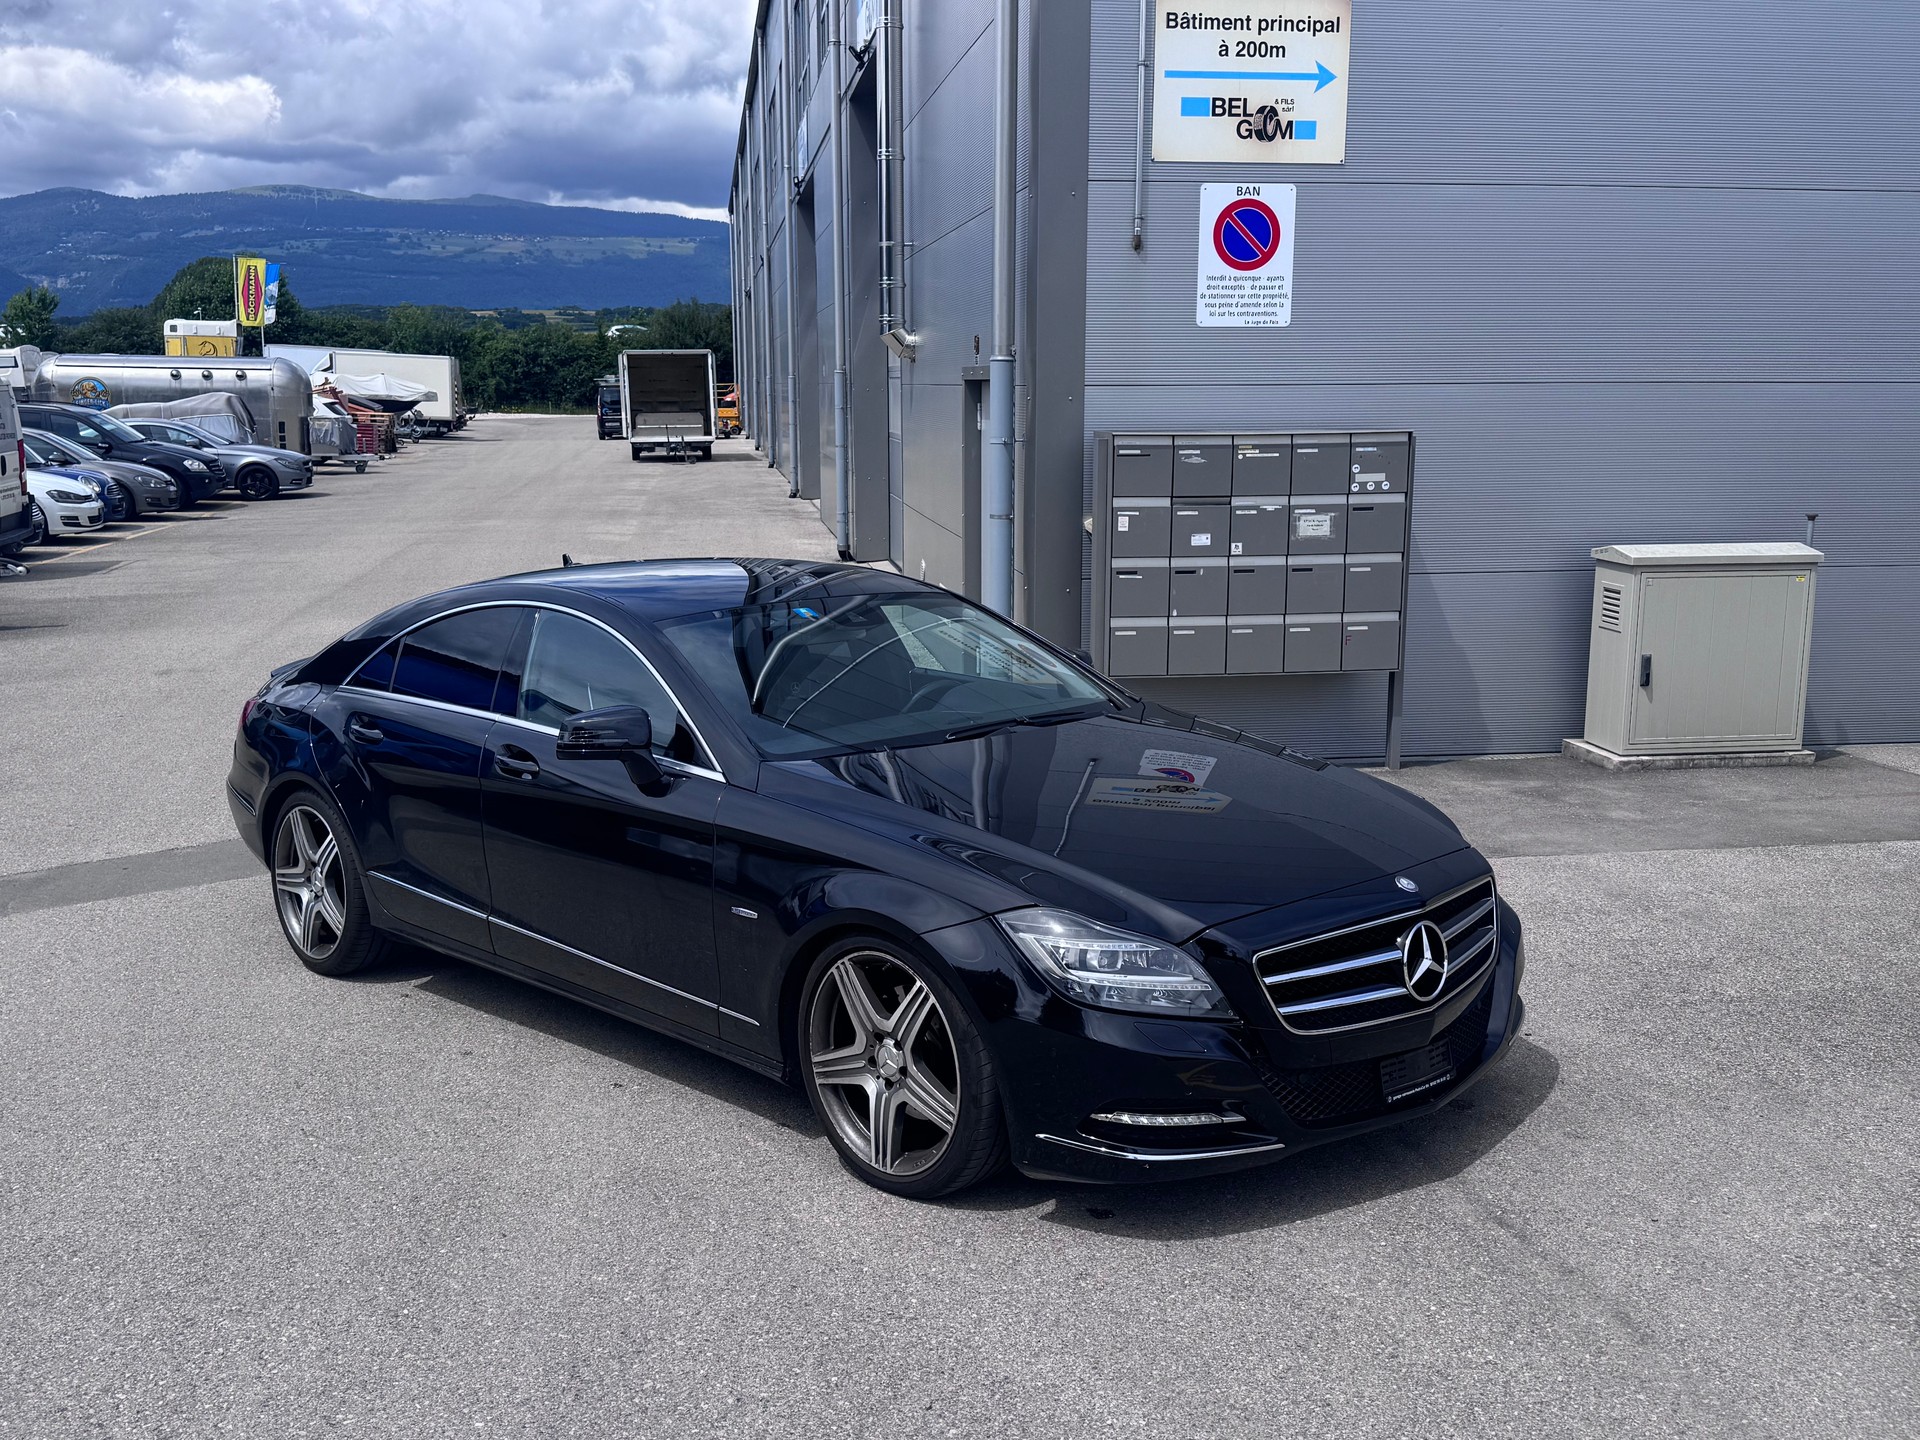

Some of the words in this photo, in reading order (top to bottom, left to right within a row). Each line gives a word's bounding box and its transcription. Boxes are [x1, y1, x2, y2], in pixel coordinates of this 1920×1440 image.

[1166, 12, 1252, 31] Bâtiment
[1257, 15, 1341, 37] principal
[1218, 40, 1229, 57] à
[1235, 41, 1286, 58] 200m
[1211, 97, 1254, 118] BEL
[1236, 186, 1261, 197] BAN
[248, 265, 256, 321] BÖCKMANN
